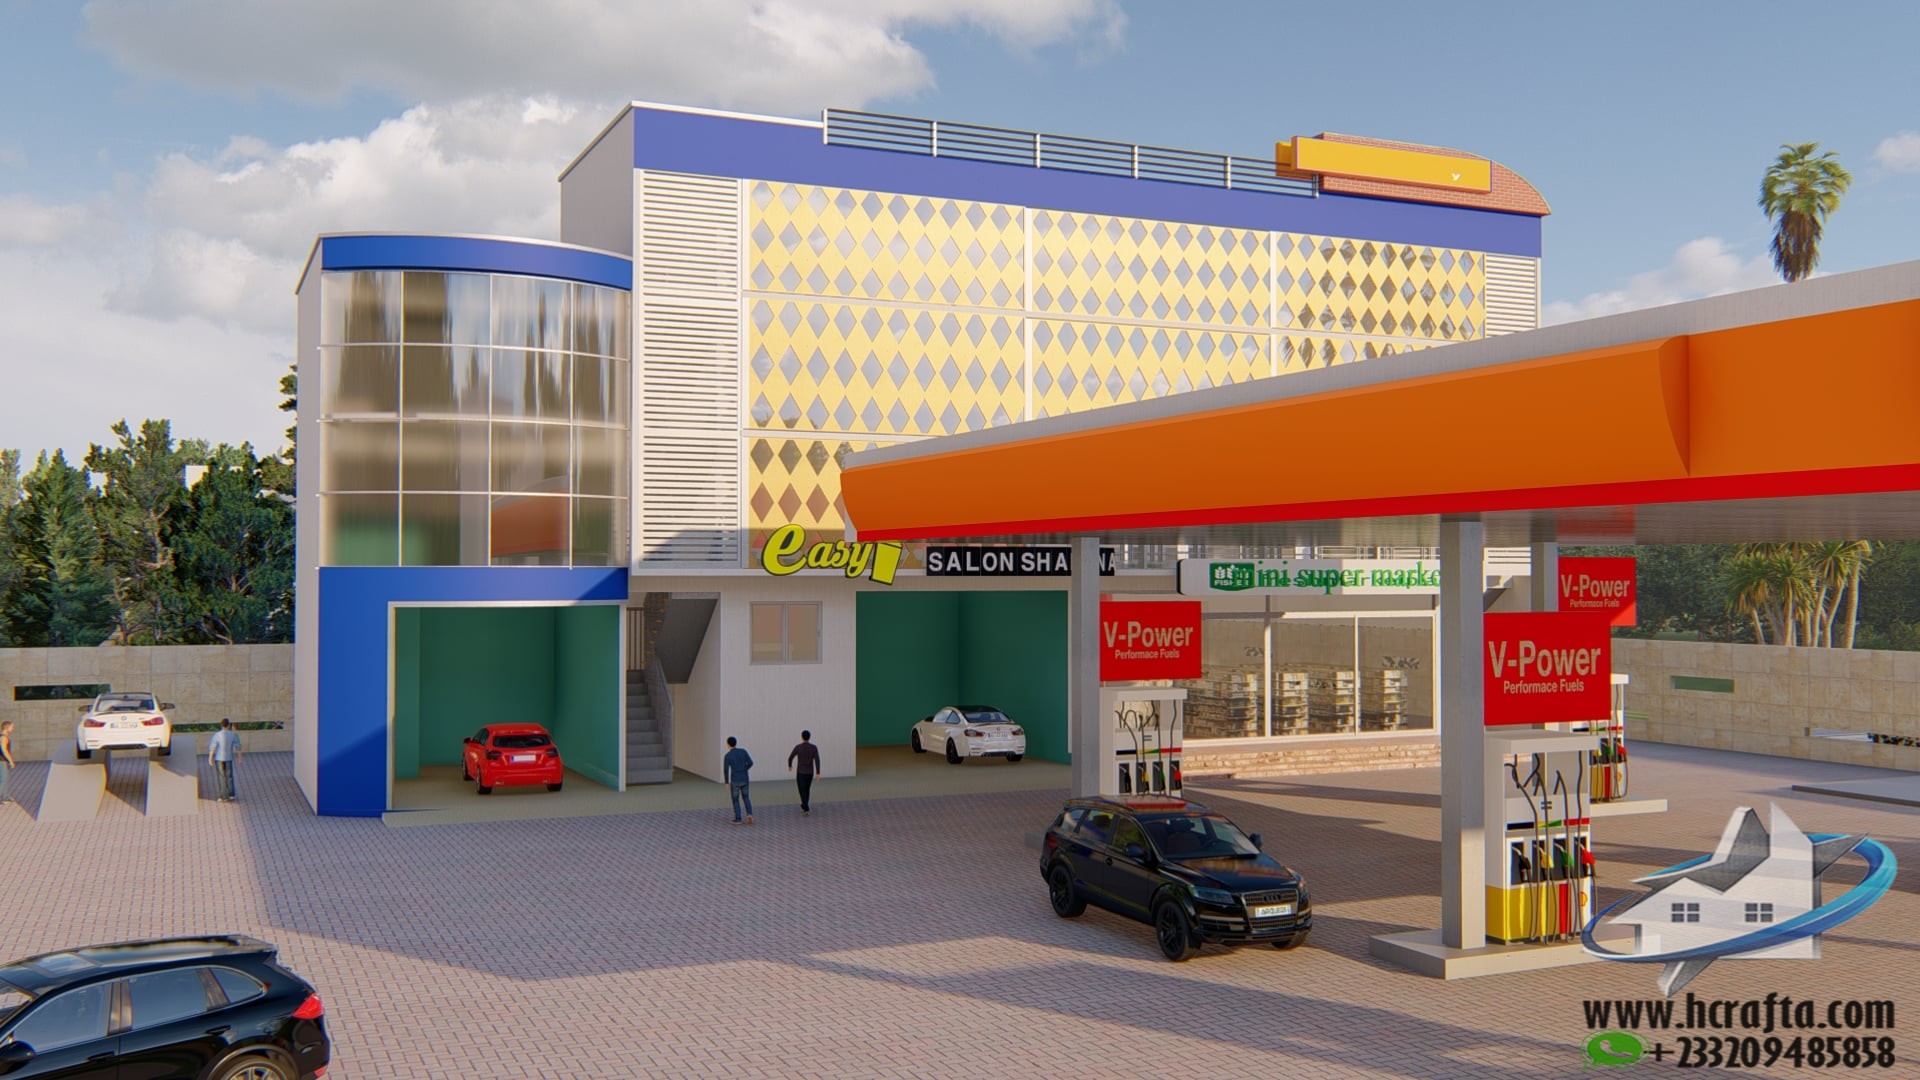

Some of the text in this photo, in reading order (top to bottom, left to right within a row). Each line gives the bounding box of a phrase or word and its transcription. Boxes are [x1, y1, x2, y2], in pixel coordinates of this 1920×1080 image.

[762, 524, 874, 579] easy
[928, 551, 1116, 572] SALON SHANA
[1297, 568, 1364, 595] super
[1370, 560, 1440, 587] marke
[1561, 574, 1630, 598] V-Power
[1604, 598, 1620, 608] Fuels
[1103, 620, 1193, 648] V-Power
[1160, 648, 1180, 658] Fuels
[1488, 640, 1601, 678] V-Power
[1504, 678, 1584, 694] Performace Fuels
